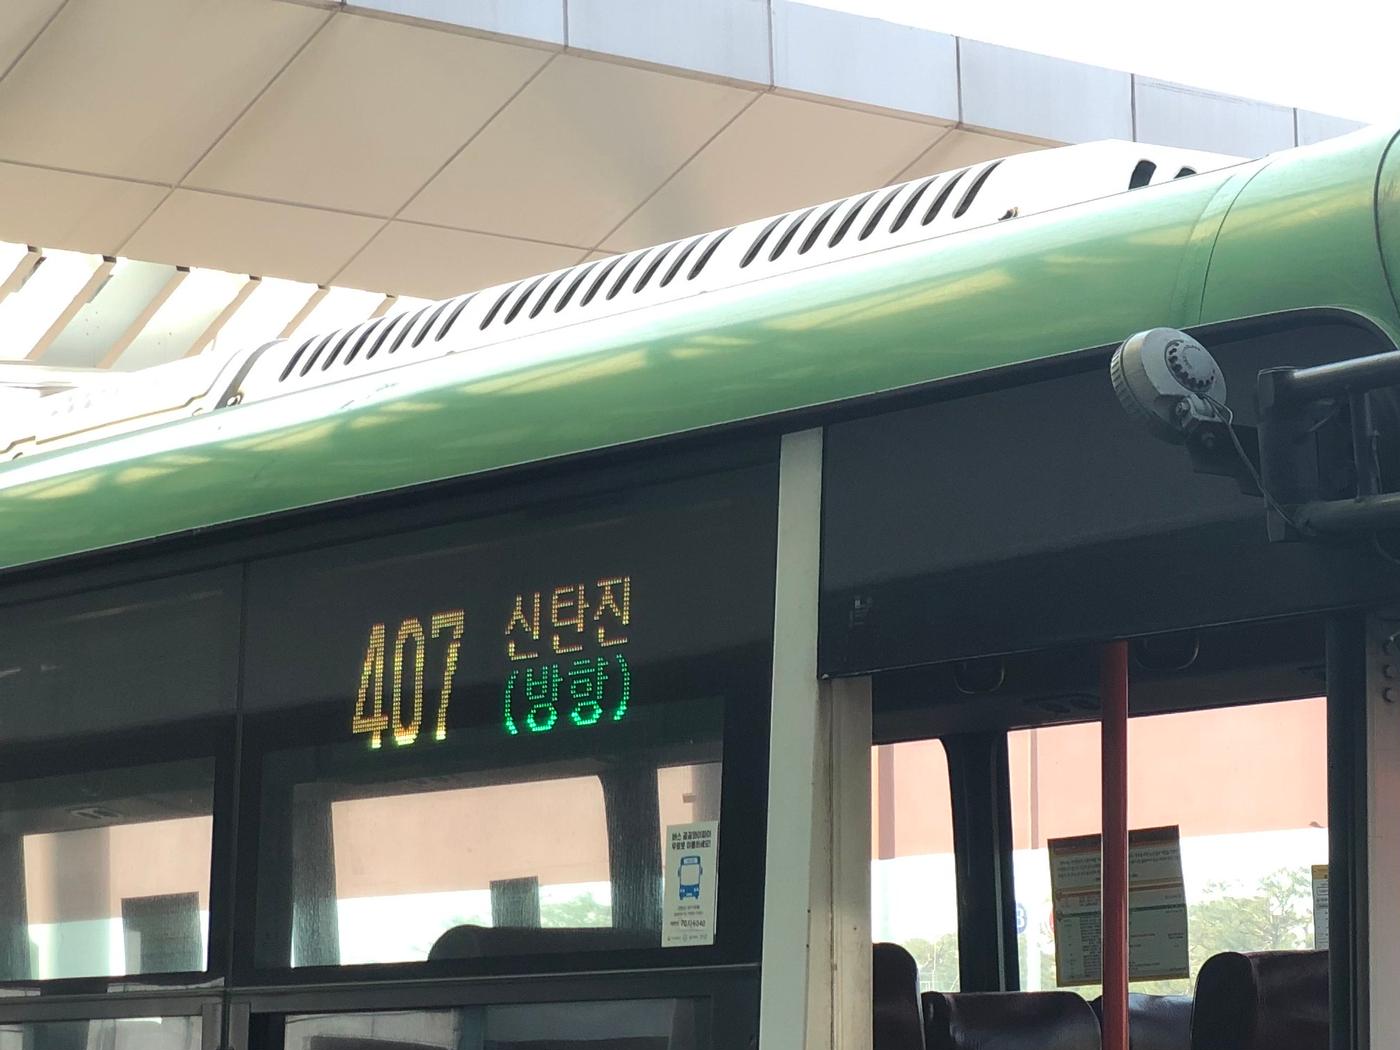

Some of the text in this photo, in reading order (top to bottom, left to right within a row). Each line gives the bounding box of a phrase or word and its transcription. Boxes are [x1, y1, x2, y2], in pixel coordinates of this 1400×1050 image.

[505, 576, 631, 661] 신탄진
[352, 609, 465, 749] 407
[504, 653, 632, 735] (방향)
